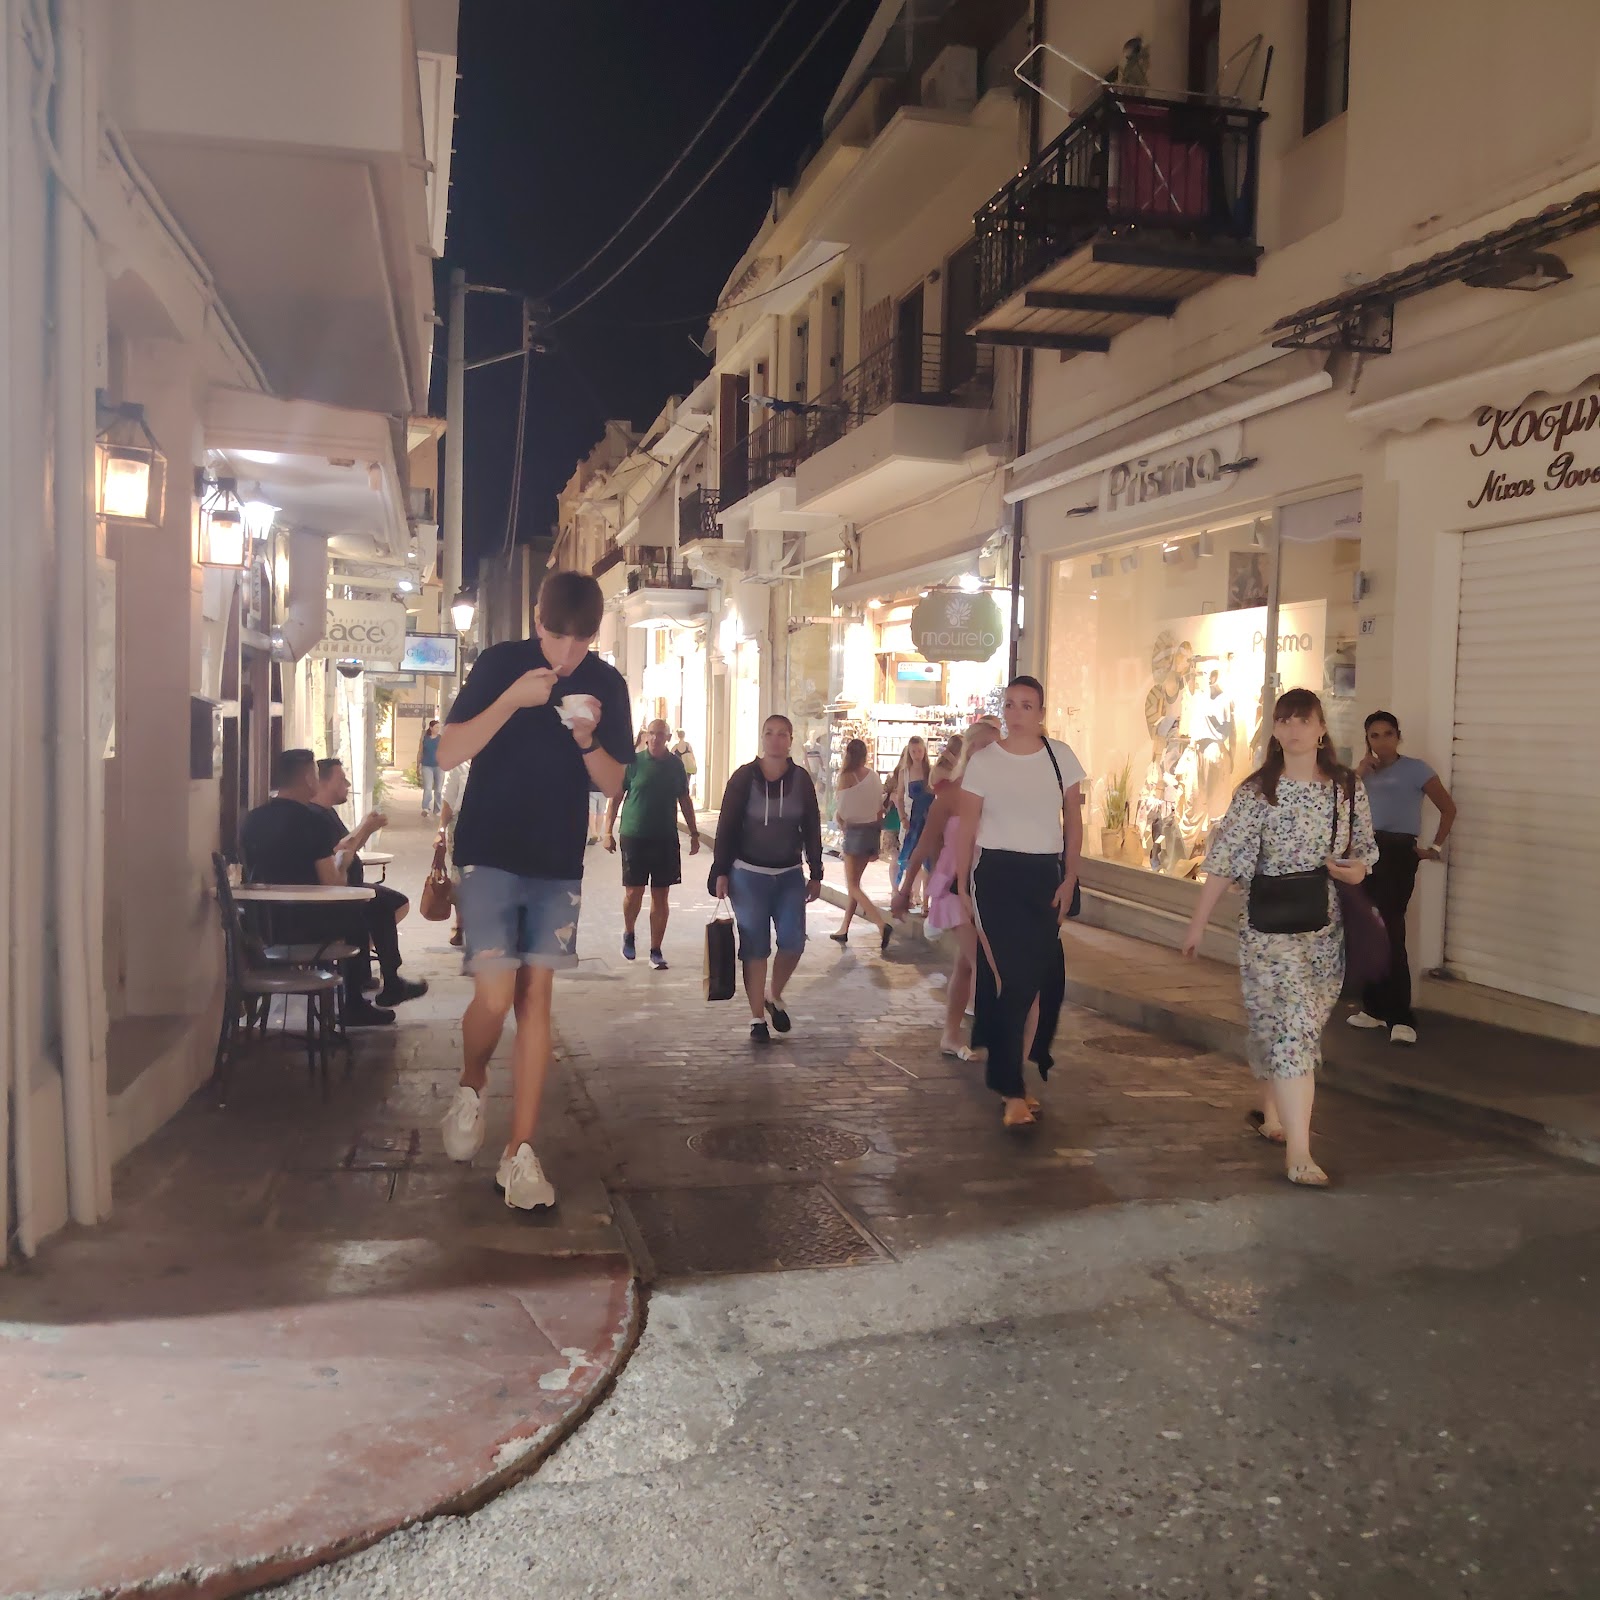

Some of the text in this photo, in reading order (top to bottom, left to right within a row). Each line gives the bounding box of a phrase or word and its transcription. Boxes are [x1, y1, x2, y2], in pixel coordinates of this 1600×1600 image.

[1106, 448, 1222, 512] Prisma
[325, 609, 386, 644] ace
[920, 629, 995, 647] mourelo
[1362, 620, 1373, 633] 87
[1252, 630, 1313, 653] Prsma
